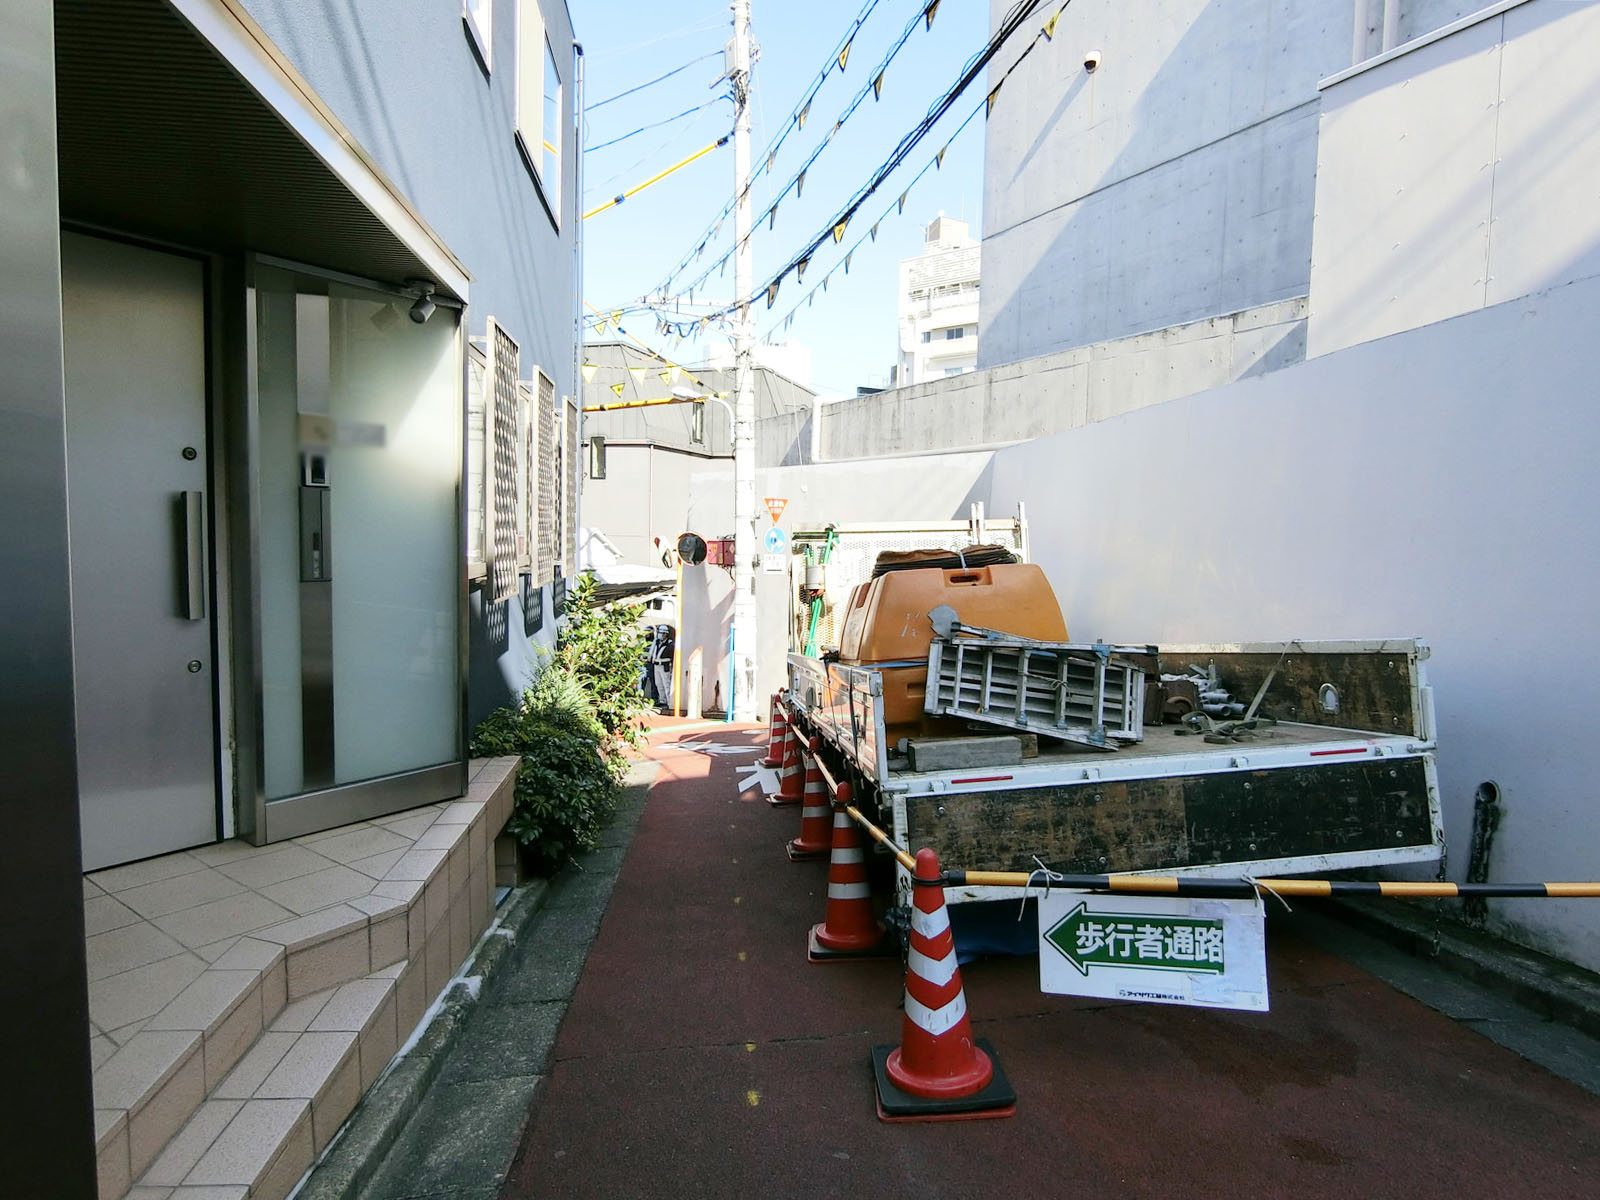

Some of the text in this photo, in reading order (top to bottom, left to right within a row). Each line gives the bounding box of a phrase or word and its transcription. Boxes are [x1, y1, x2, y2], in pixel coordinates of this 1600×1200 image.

[1076, 922, 1223, 963] 歩行者通路
